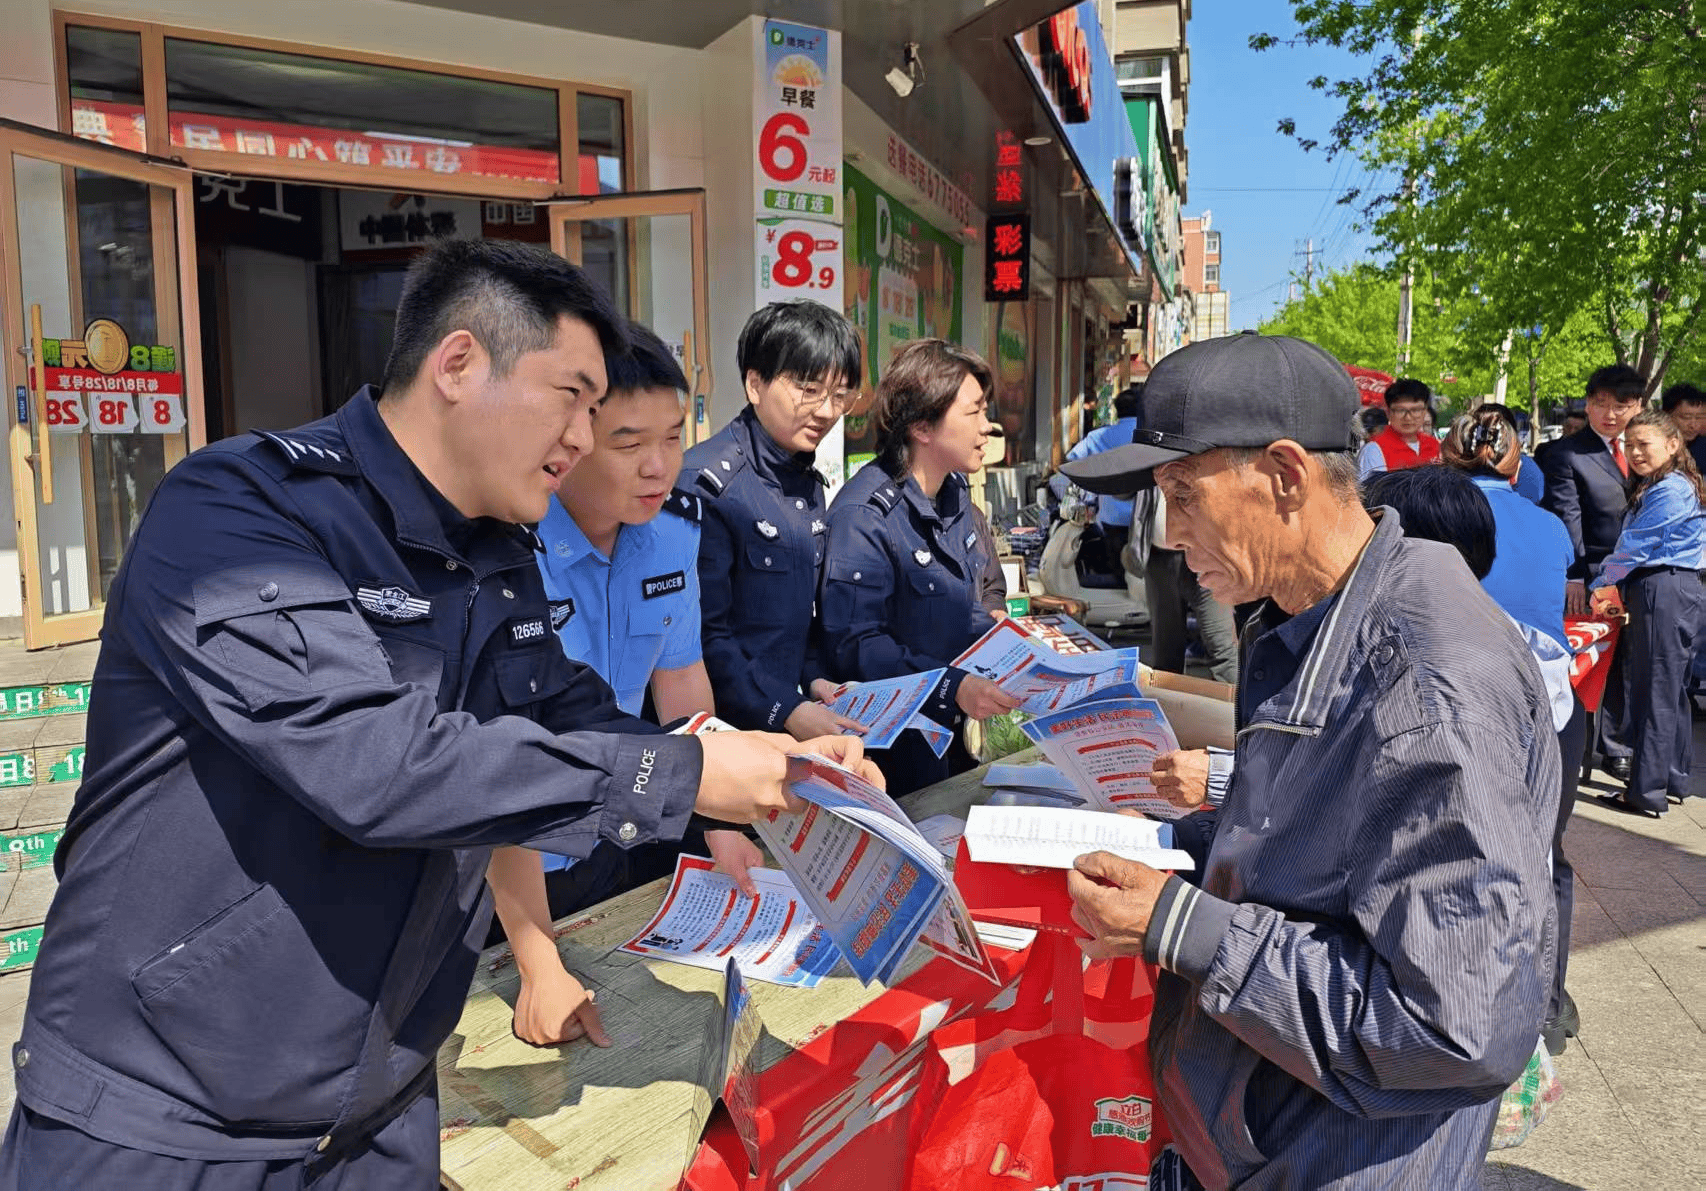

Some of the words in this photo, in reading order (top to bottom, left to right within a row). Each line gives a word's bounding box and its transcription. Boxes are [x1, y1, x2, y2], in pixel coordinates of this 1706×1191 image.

[781, 87, 816, 109] 早餐
[775, 192, 825, 212] 超值选
[993, 224, 1023, 292] 彩票
[512, 620, 544, 640] 126566
[939, 677, 951, 700] POLICE
[767, 700, 782, 726] POLICE
[633, 748, 656, 795] POLICE
